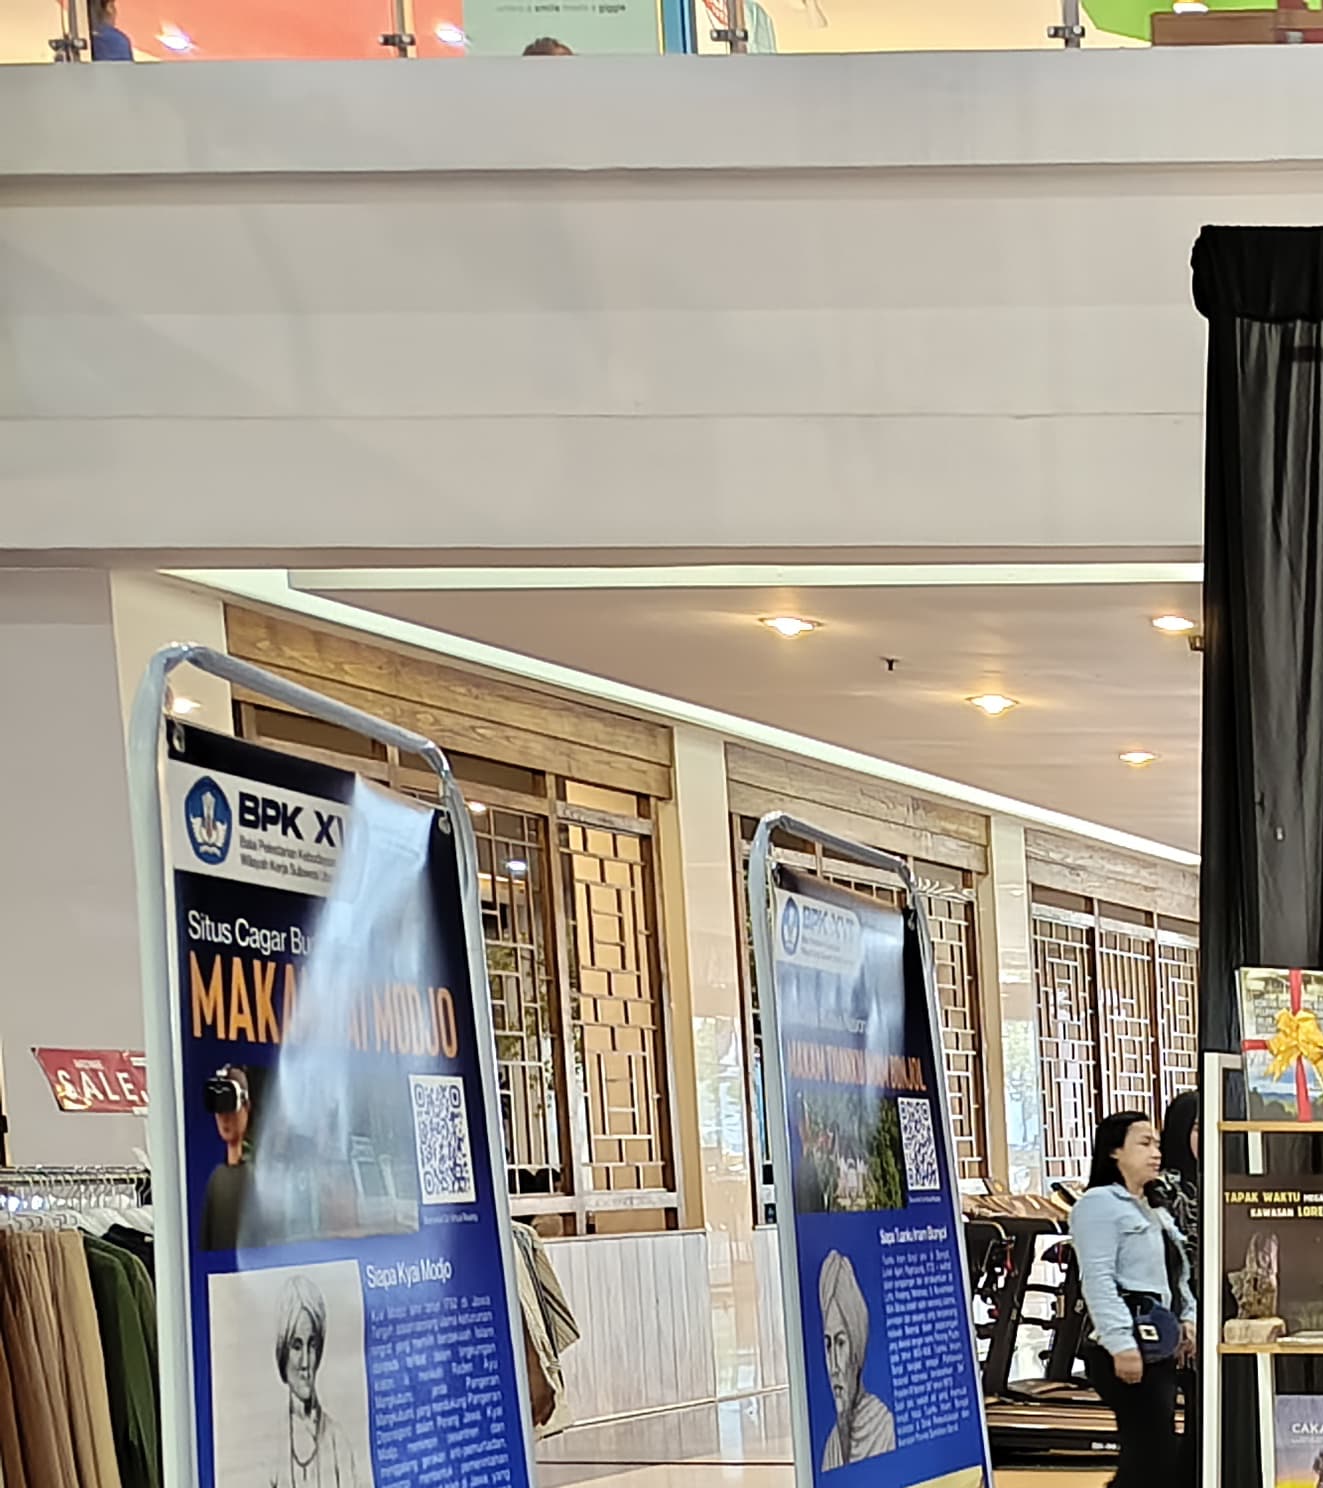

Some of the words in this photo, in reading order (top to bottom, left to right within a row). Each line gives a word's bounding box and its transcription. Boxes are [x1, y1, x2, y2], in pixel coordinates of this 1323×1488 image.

[238, 791, 303, 841] BPK
[188, 910, 232, 945] Situs
[235, 917, 287, 955] Cagar
[57, 1069, 138, 1102] SALE
[1224, 1191, 1259, 1203] TAPAK
[1262, 1191, 1300, 1203] WAKTU
